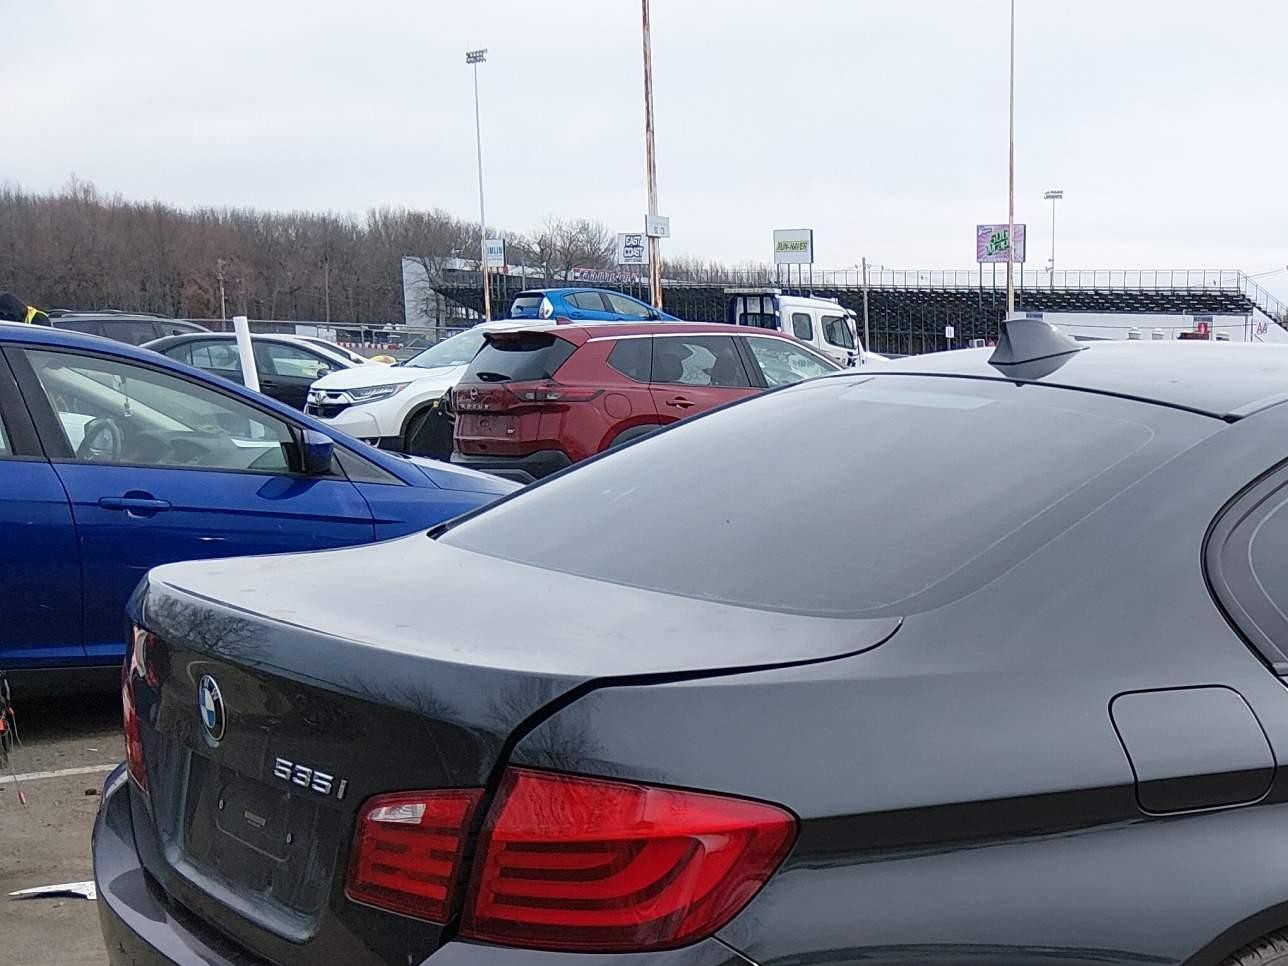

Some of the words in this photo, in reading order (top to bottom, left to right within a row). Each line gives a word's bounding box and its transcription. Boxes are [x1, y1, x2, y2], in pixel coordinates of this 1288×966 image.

[625, 235, 642, 246] EAST
[623, 246, 644, 258] COAST
[273, 756, 348, 800] 535i
